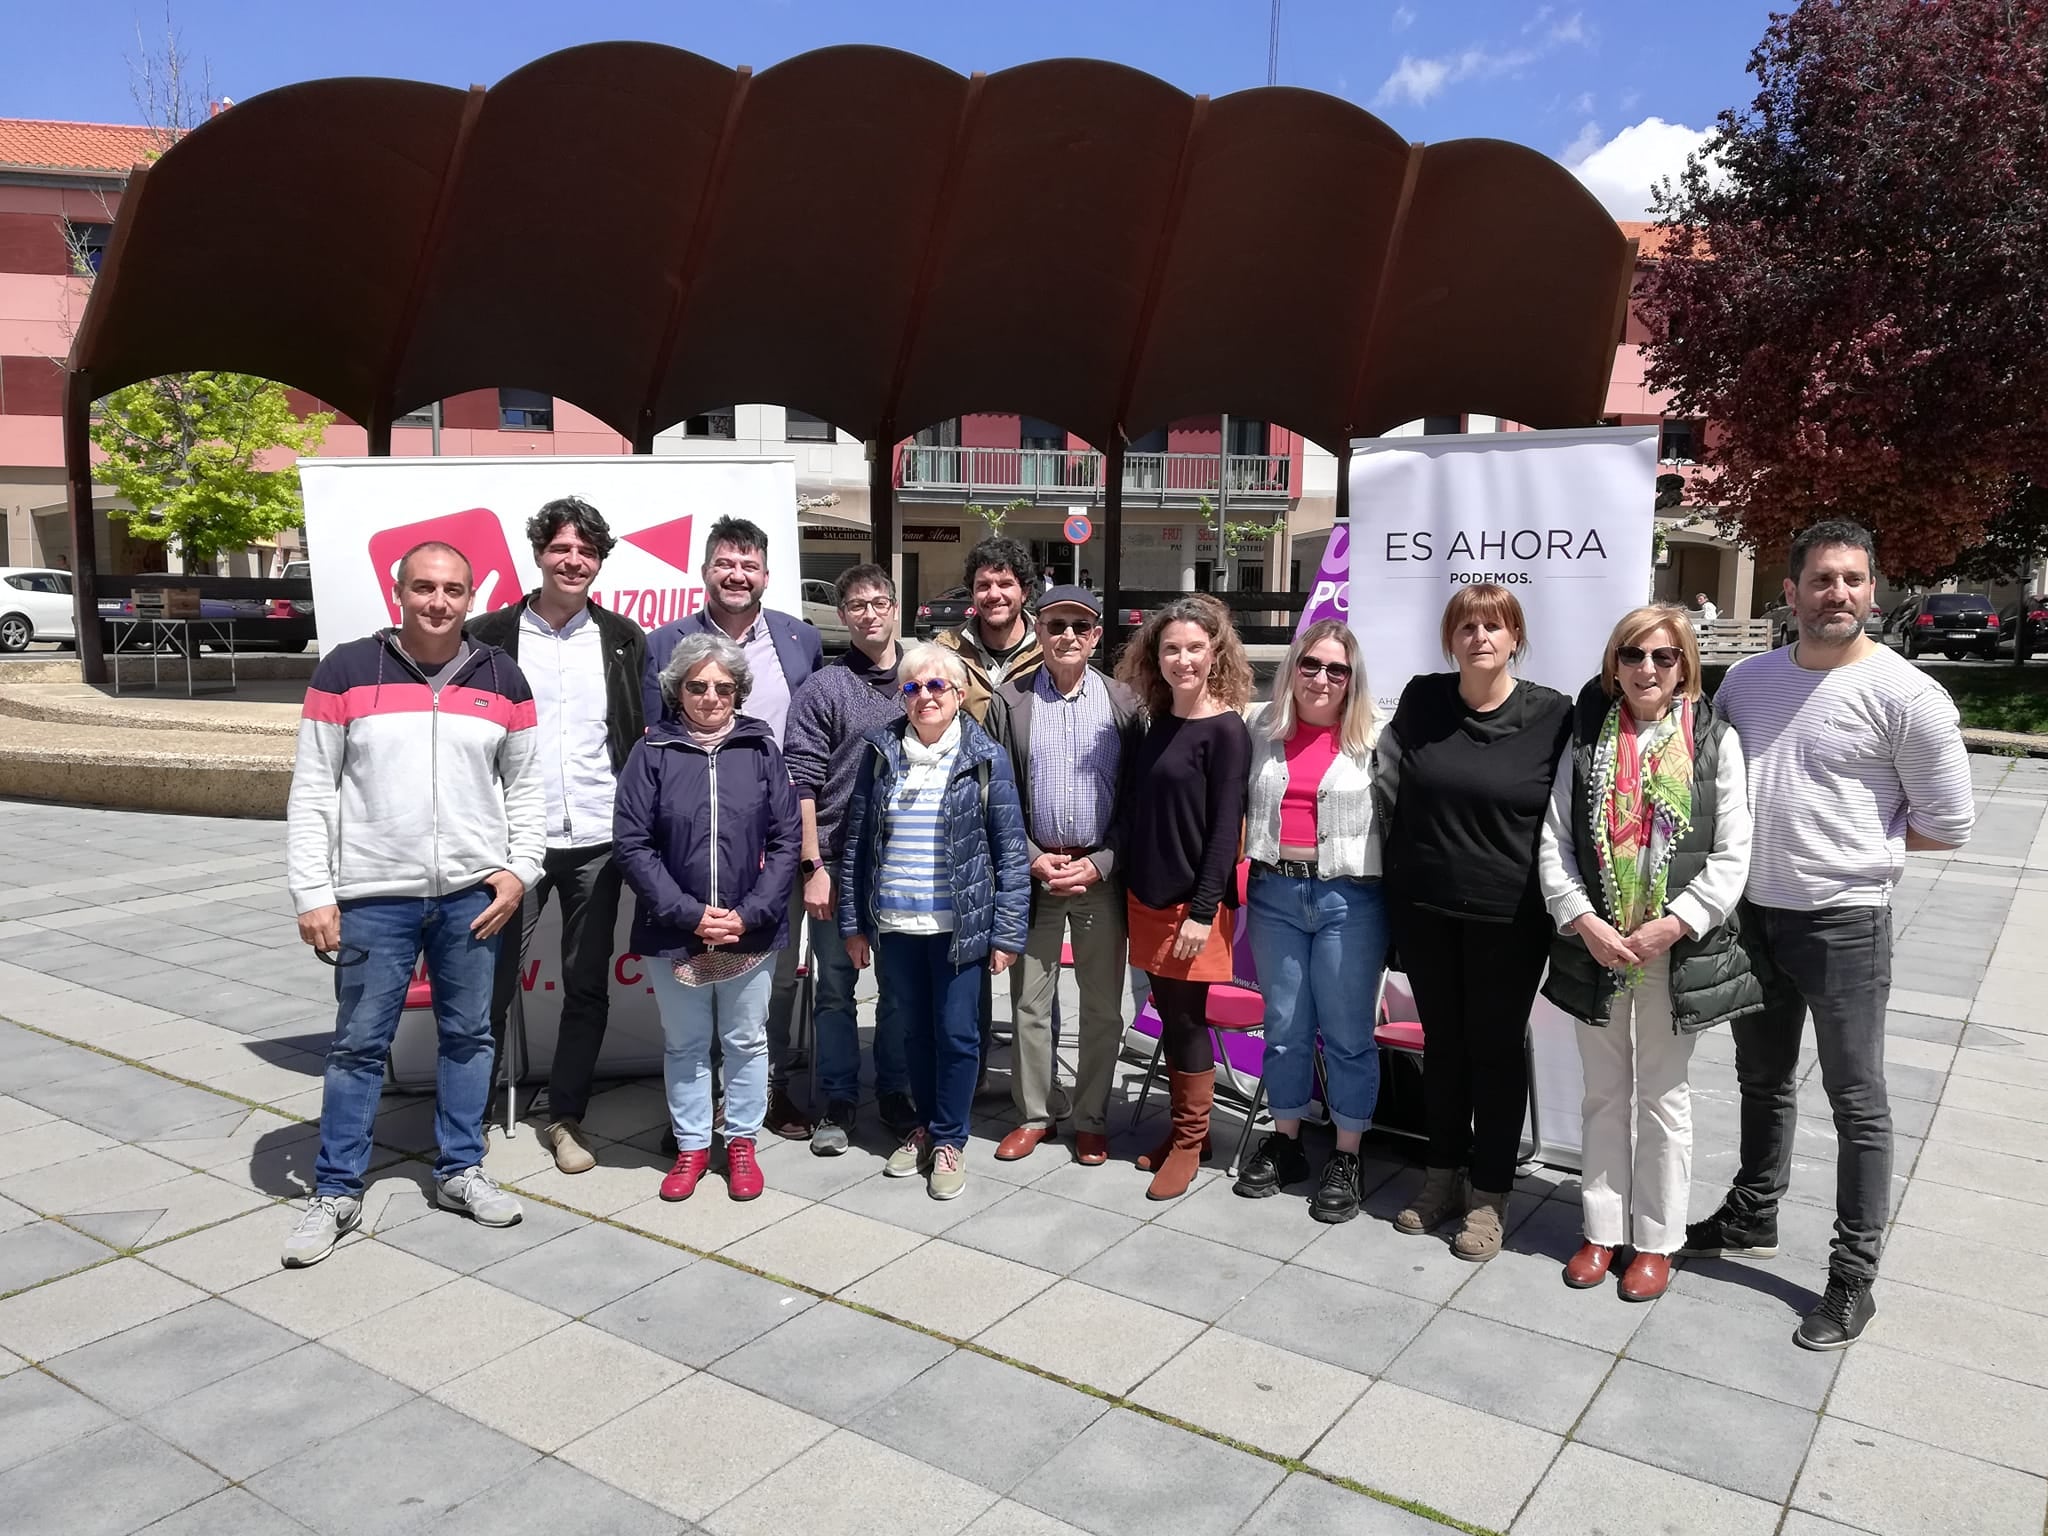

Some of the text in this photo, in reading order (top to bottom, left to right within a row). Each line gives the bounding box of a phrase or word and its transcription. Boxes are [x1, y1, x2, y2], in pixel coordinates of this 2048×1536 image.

[1058, 545, 1070, 557] 16
[1386, 529, 1608, 561] ES AHORA
[1450, 572, 1533, 585] PODEMOS.
[1309, 581, 1350, 612] PO
[612, 588, 709, 630] IZQUIE
[1378, 697, 1400, 706] AHO
